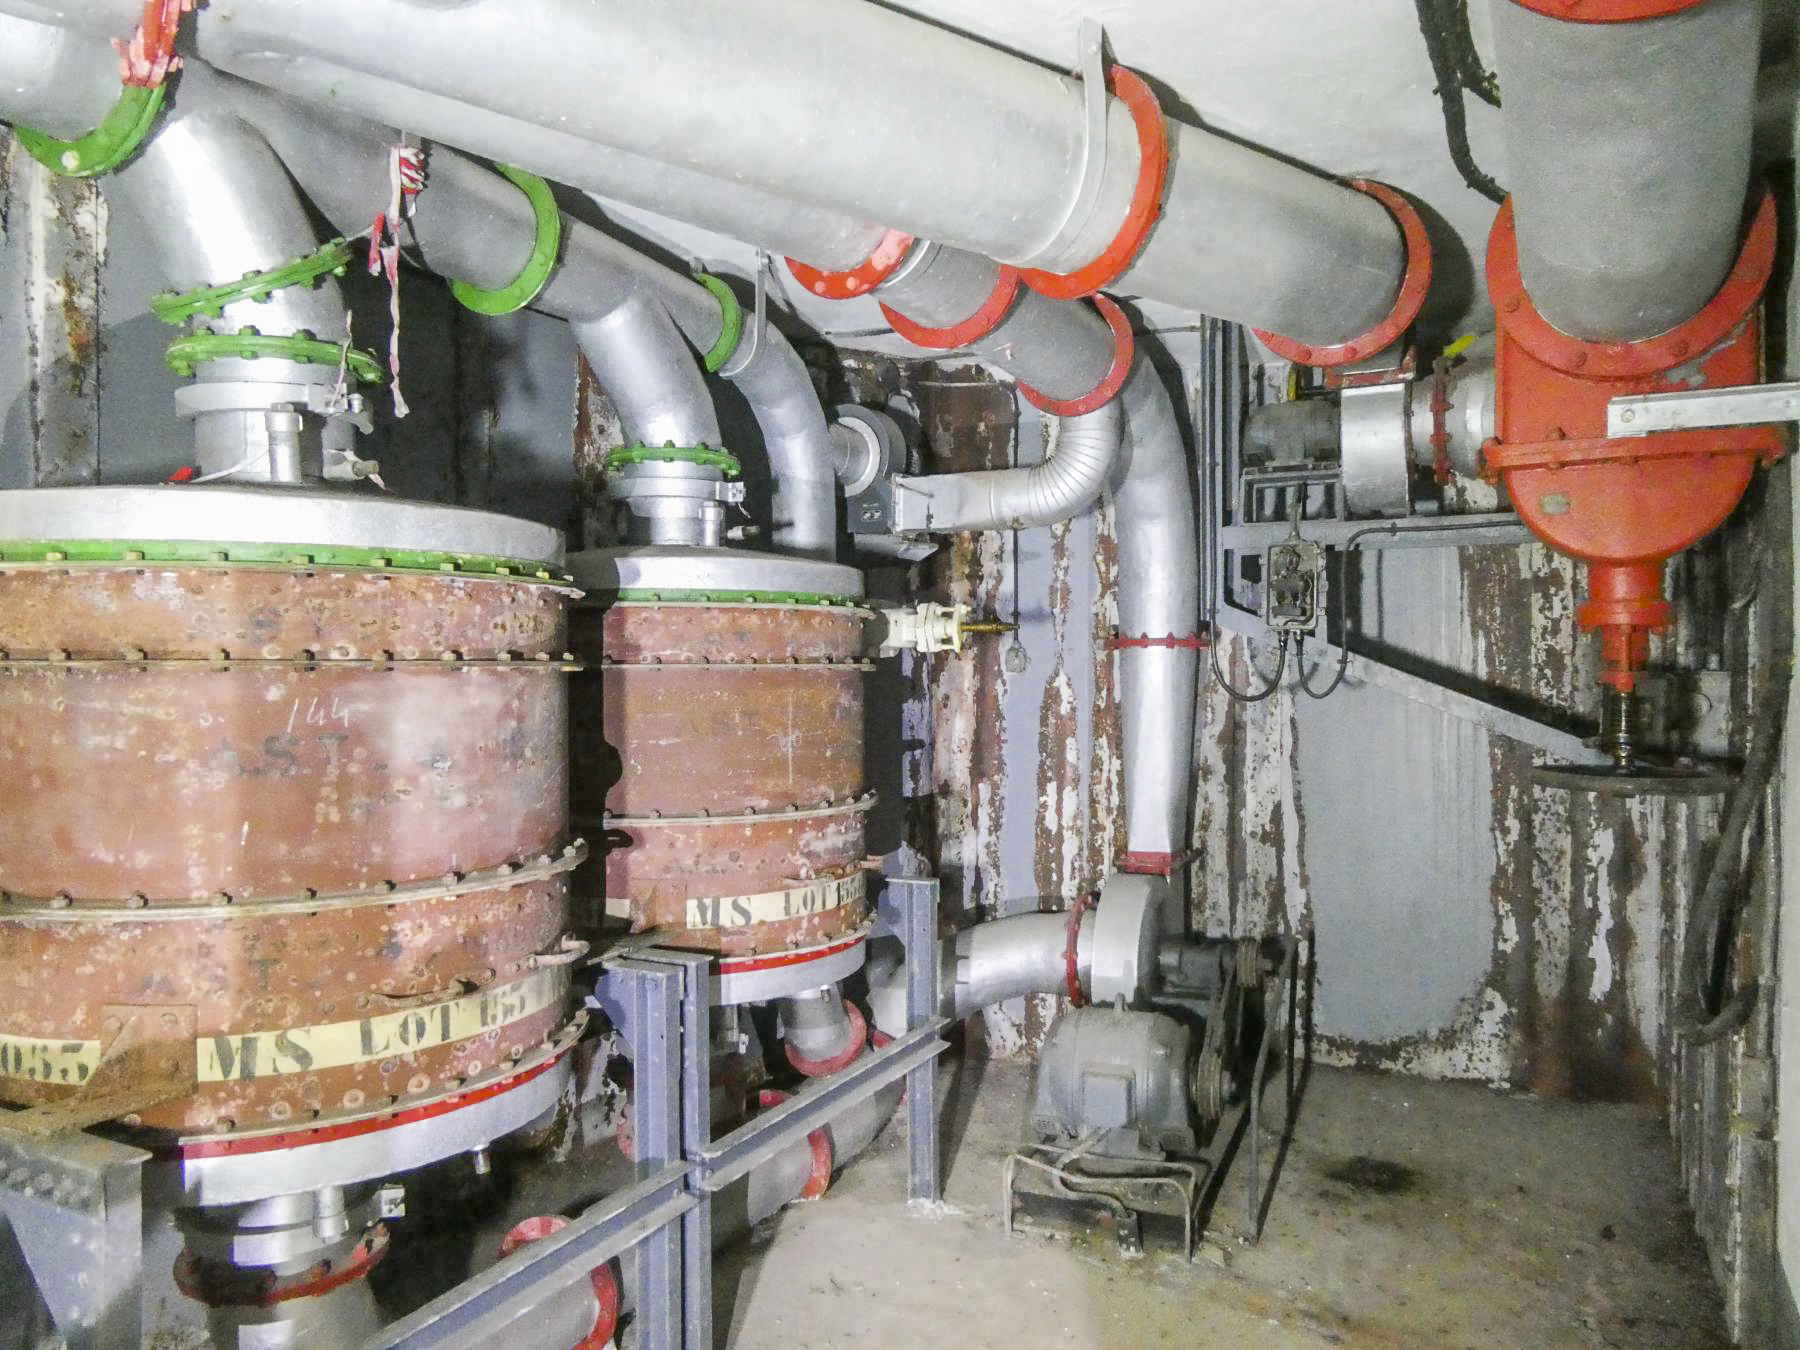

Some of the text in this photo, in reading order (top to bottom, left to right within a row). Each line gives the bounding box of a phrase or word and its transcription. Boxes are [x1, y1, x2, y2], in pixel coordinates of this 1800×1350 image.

[286, 696, 349, 733] 144
[692, 895, 752, 929] MS
[784, 883, 832, 917] LOT
[209, 1029, 314, 1082] MS
[359, 1001, 460, 1056] LOT
